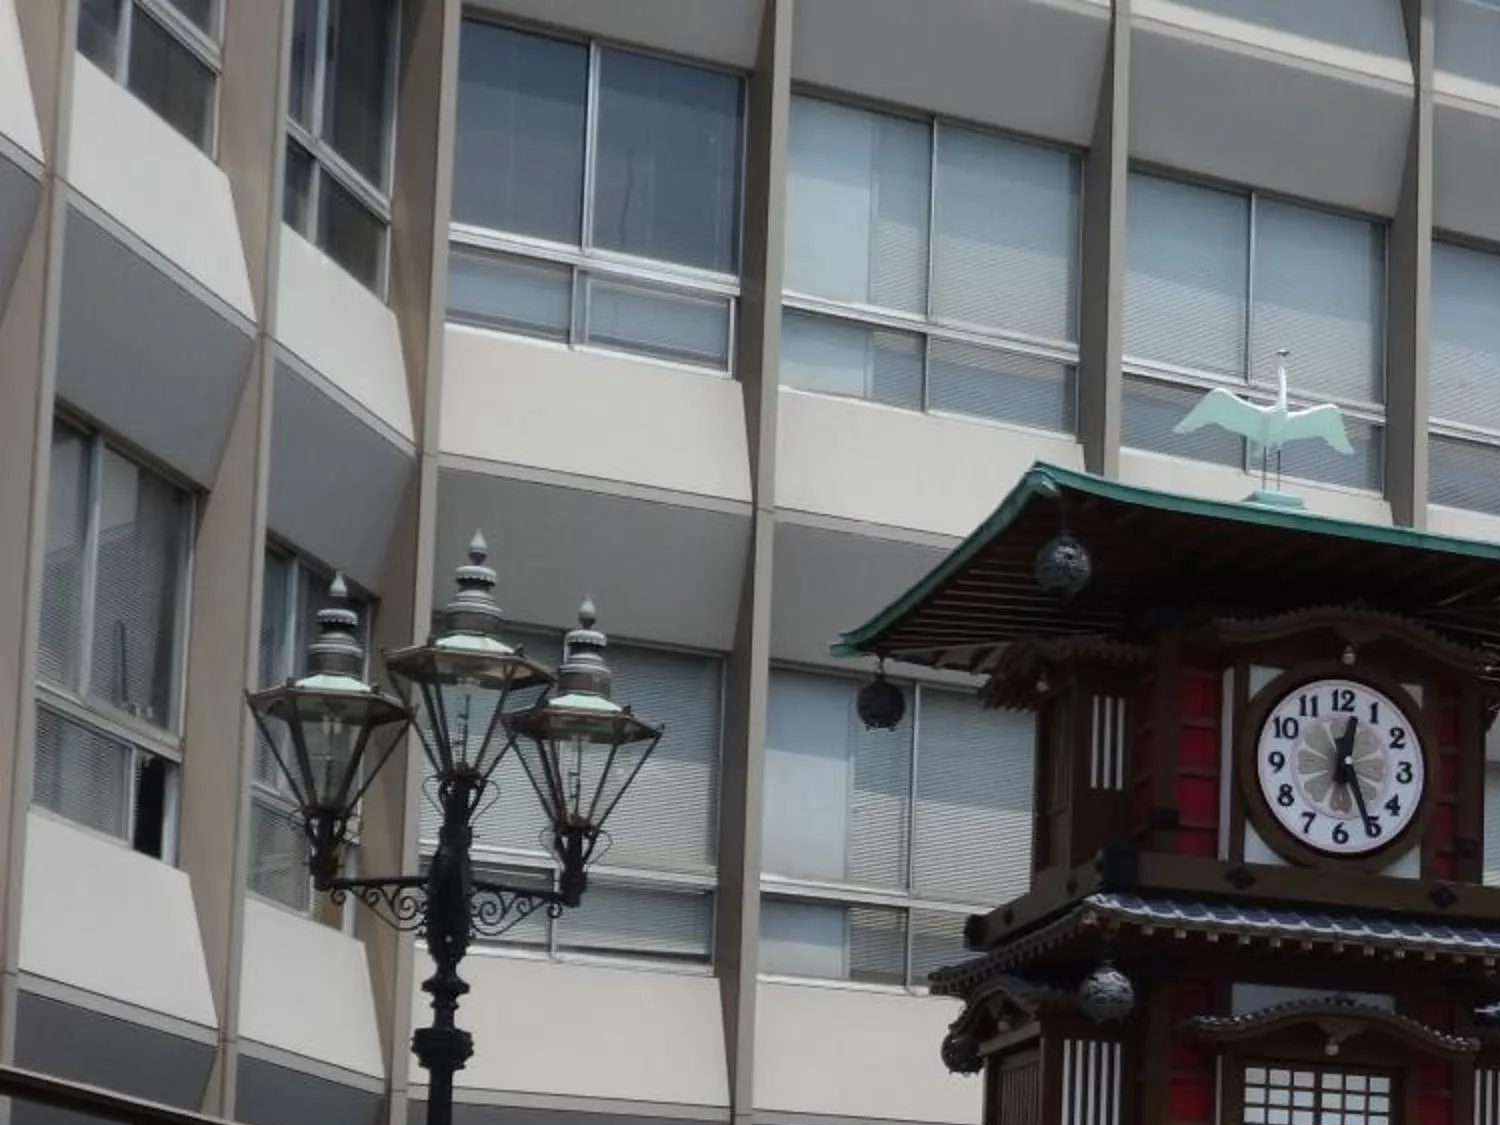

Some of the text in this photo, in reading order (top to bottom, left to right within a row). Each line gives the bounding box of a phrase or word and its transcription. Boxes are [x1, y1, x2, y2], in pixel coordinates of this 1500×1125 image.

[1299, 694, 1319, 717] 11
[1331, 688, 1355, 712] 12
[1369, 702, 1379, 724] 1
[1273, 716, 1299, 740] 10
[1389, 727, 1405, 749] 2
[1268, 751, 1285, 774] 9
[1395, 761, 1413, 784] 3
[1277, 783, 1294, 807] 8
[1384, 793, 1401, 817] 4
[1301, 811, 1316, 834] 7
[1332, 822, 1349, 844] 6
[1367, 815, 1382, 837] 5
